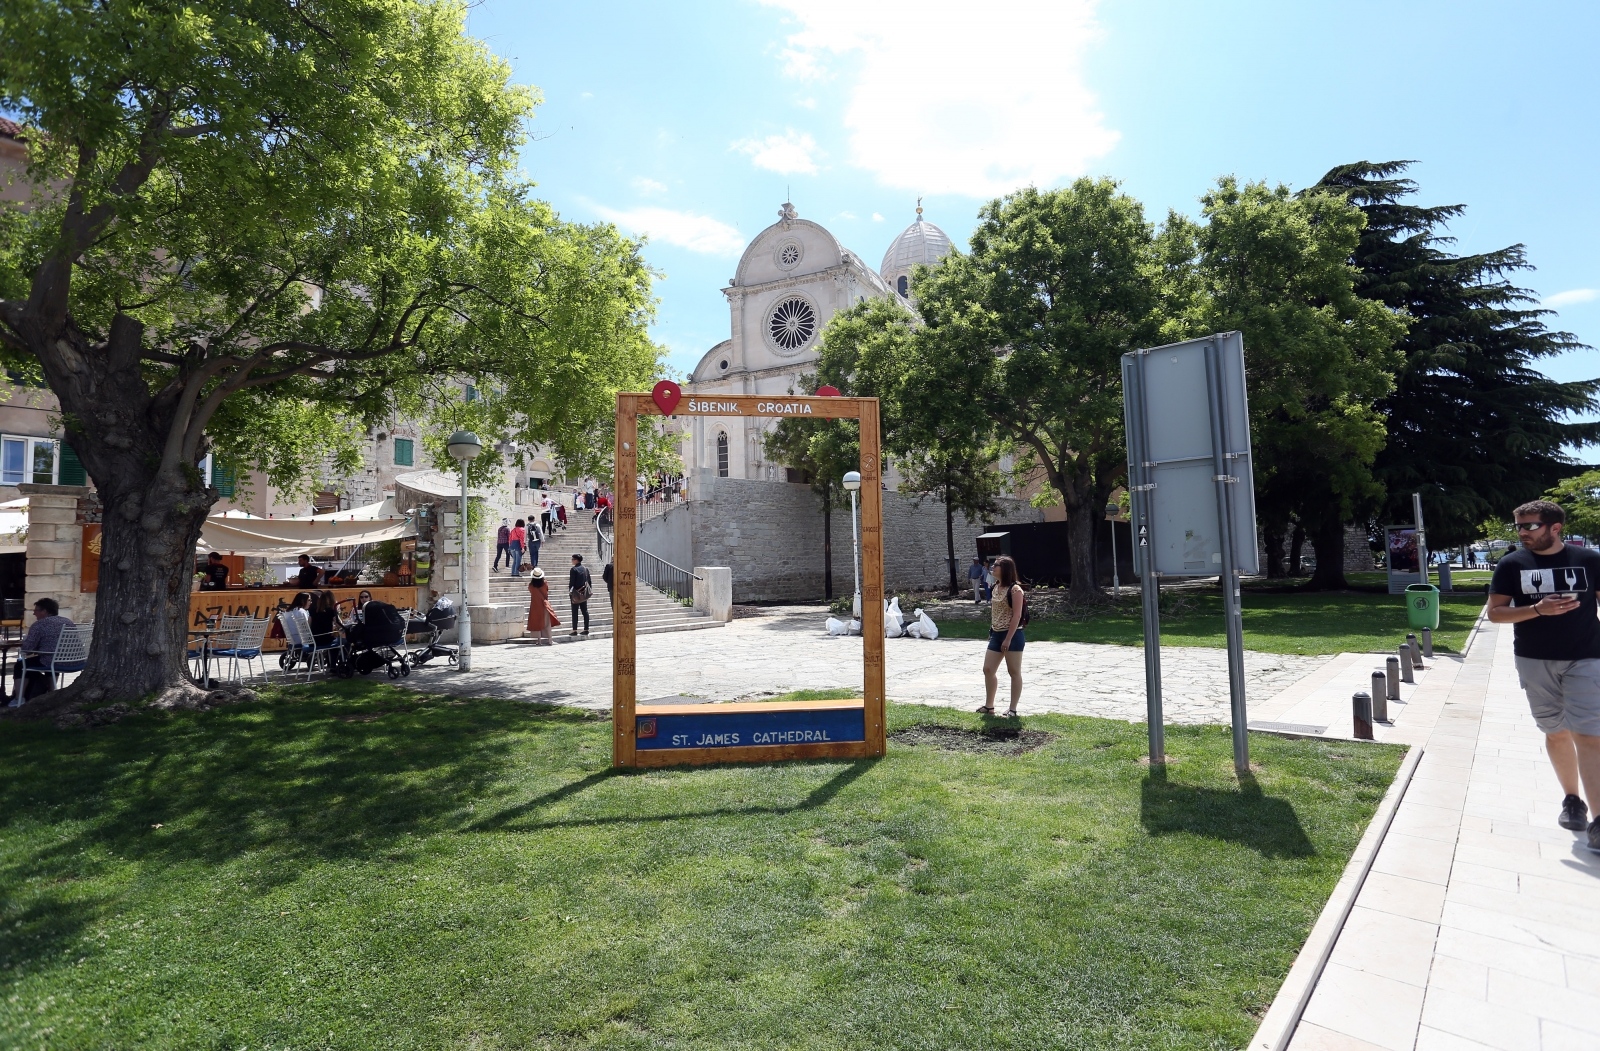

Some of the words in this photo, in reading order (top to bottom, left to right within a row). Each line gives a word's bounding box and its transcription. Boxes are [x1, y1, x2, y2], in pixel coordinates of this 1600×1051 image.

[757, 402, 812, 414] CROATIA
[672, 734, 691, 747] ST.
[696, 732, 740, 746] JAMES
[752, 730, 831, 743] CATHEDRAL
